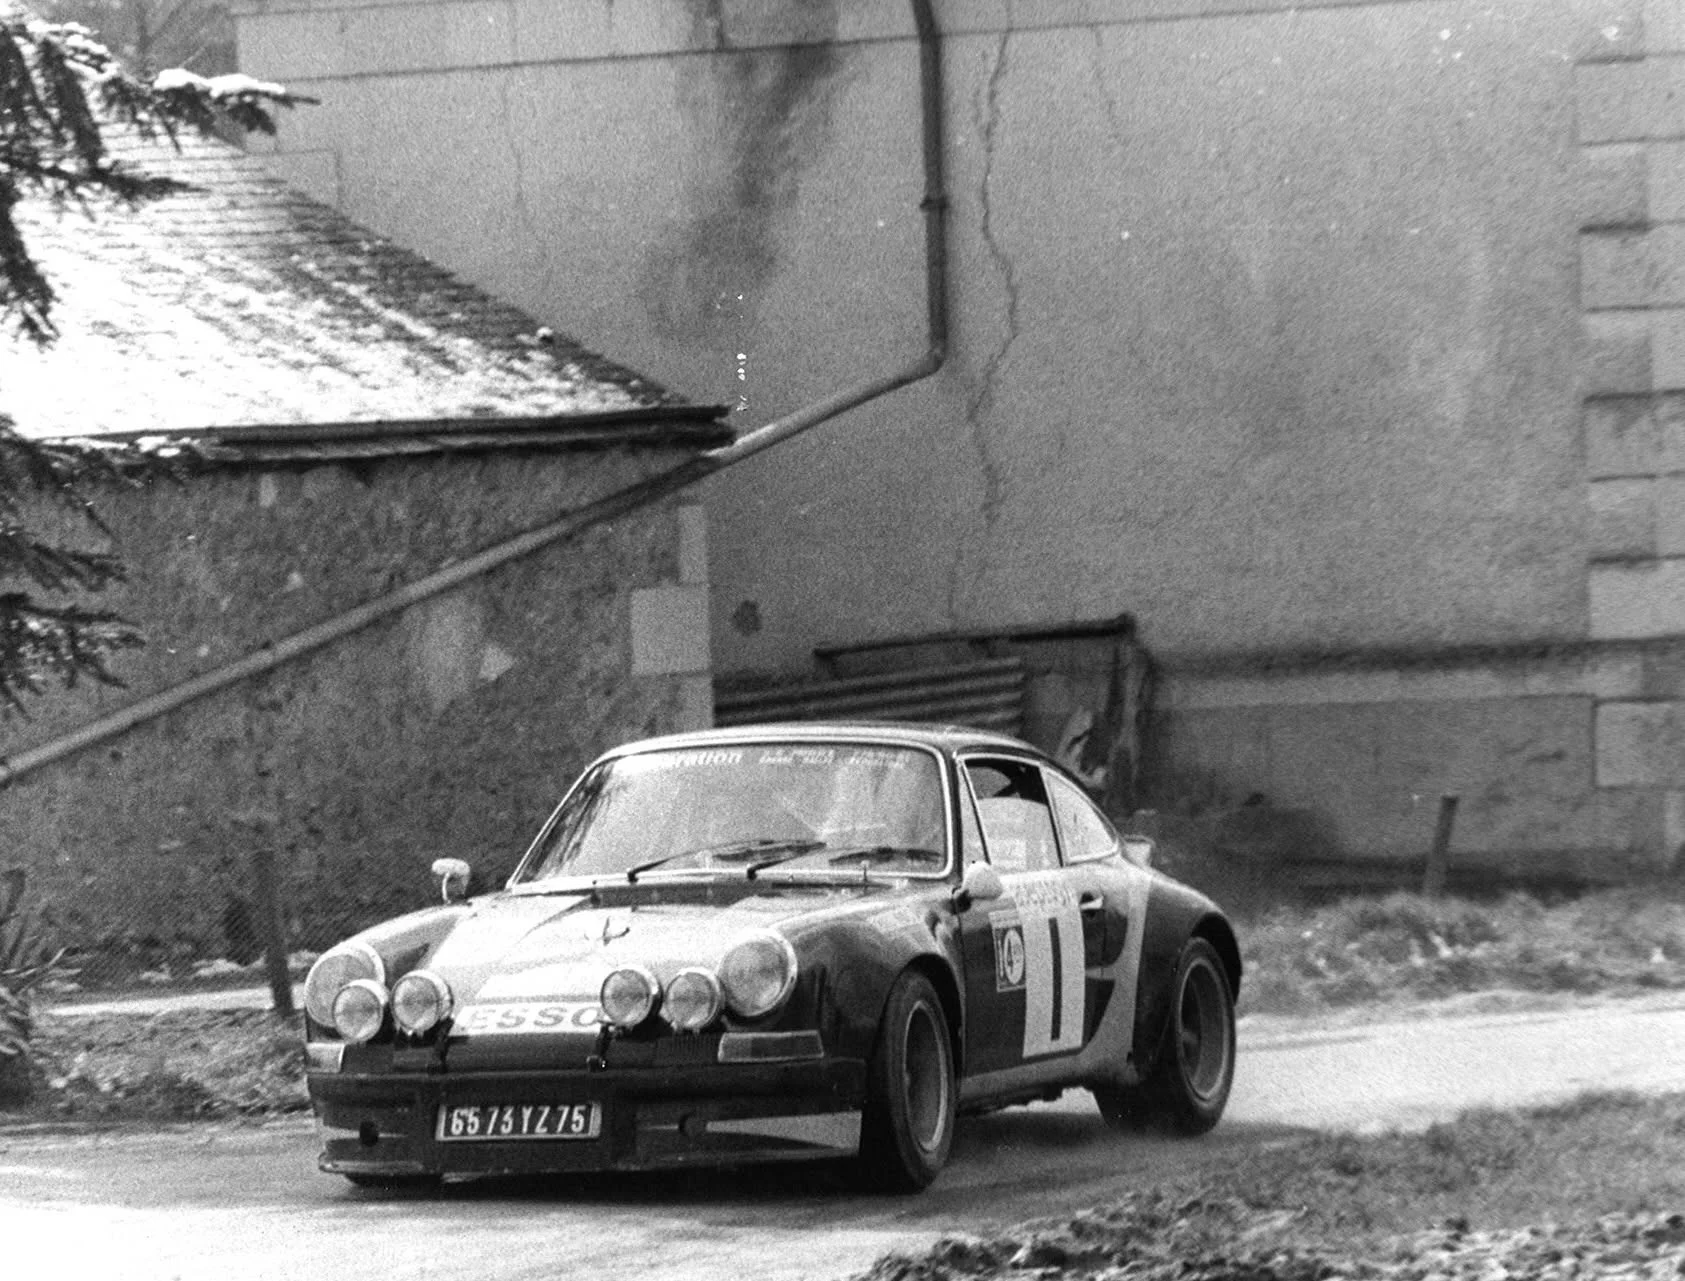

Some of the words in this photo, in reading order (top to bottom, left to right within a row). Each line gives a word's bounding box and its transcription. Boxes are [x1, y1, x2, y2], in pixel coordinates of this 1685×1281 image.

[1047, 916, 1063, 1042] 1
[469, 1006, 604, 1029] ESSO
[521, 1105, 551, 1134] YZ
[556, 1105, 587, 1134] 75
